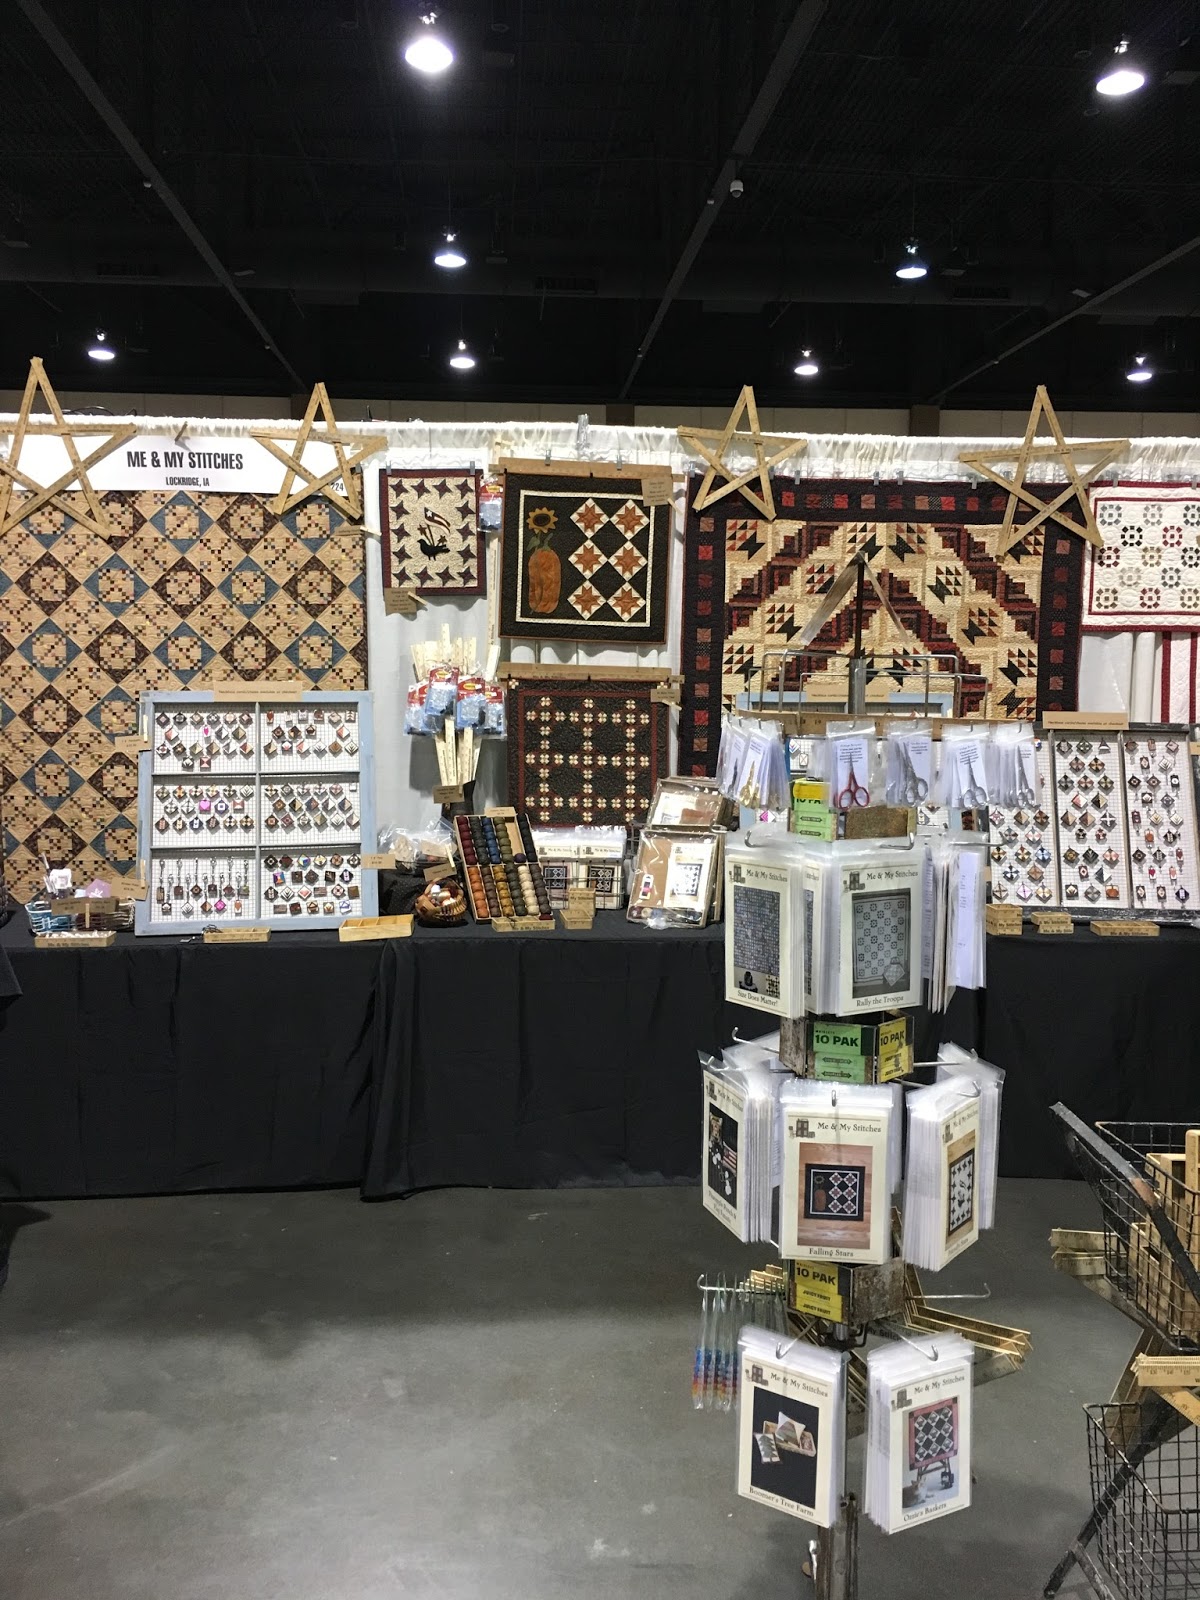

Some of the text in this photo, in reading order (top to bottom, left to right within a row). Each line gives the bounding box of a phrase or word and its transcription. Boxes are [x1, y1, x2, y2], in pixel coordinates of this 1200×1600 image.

[126, 451, 244, 470] ME & MY STITCHES
[166, 476, 210, 487] LOCKRIDGE, IA
[769, 873, 787, 882] Stitches
[895, 869, 918, 878] Stitches
[883, 996, 904, 1004] Troops
[815, 1035, 859, 1047] 10 PAK
[880, 1035, 889, 1046] 10
[890, 1030, 904, 1044] PAK
[831, 1123, 838, 1131] &
[840, 1123, 851, 1132] My
[853, 1124, 881, 1132] Stitches
[809, 1248, 854, 1257] Falling Stars
[796, 1267, 836, 1286] 10 PAK
[770, 1372, 780, 1381] Me
[790, 1379, 800, 1389] My
[802, 1383, 828, 1397] Stitches
[932, 1381, 941, 1389] My
[942, 1376, 965, 1386] Stitches
[749, 1487, 814, 1517] Boomer's Tree Farm
[925, 1503, 947, 1515] Baskets
